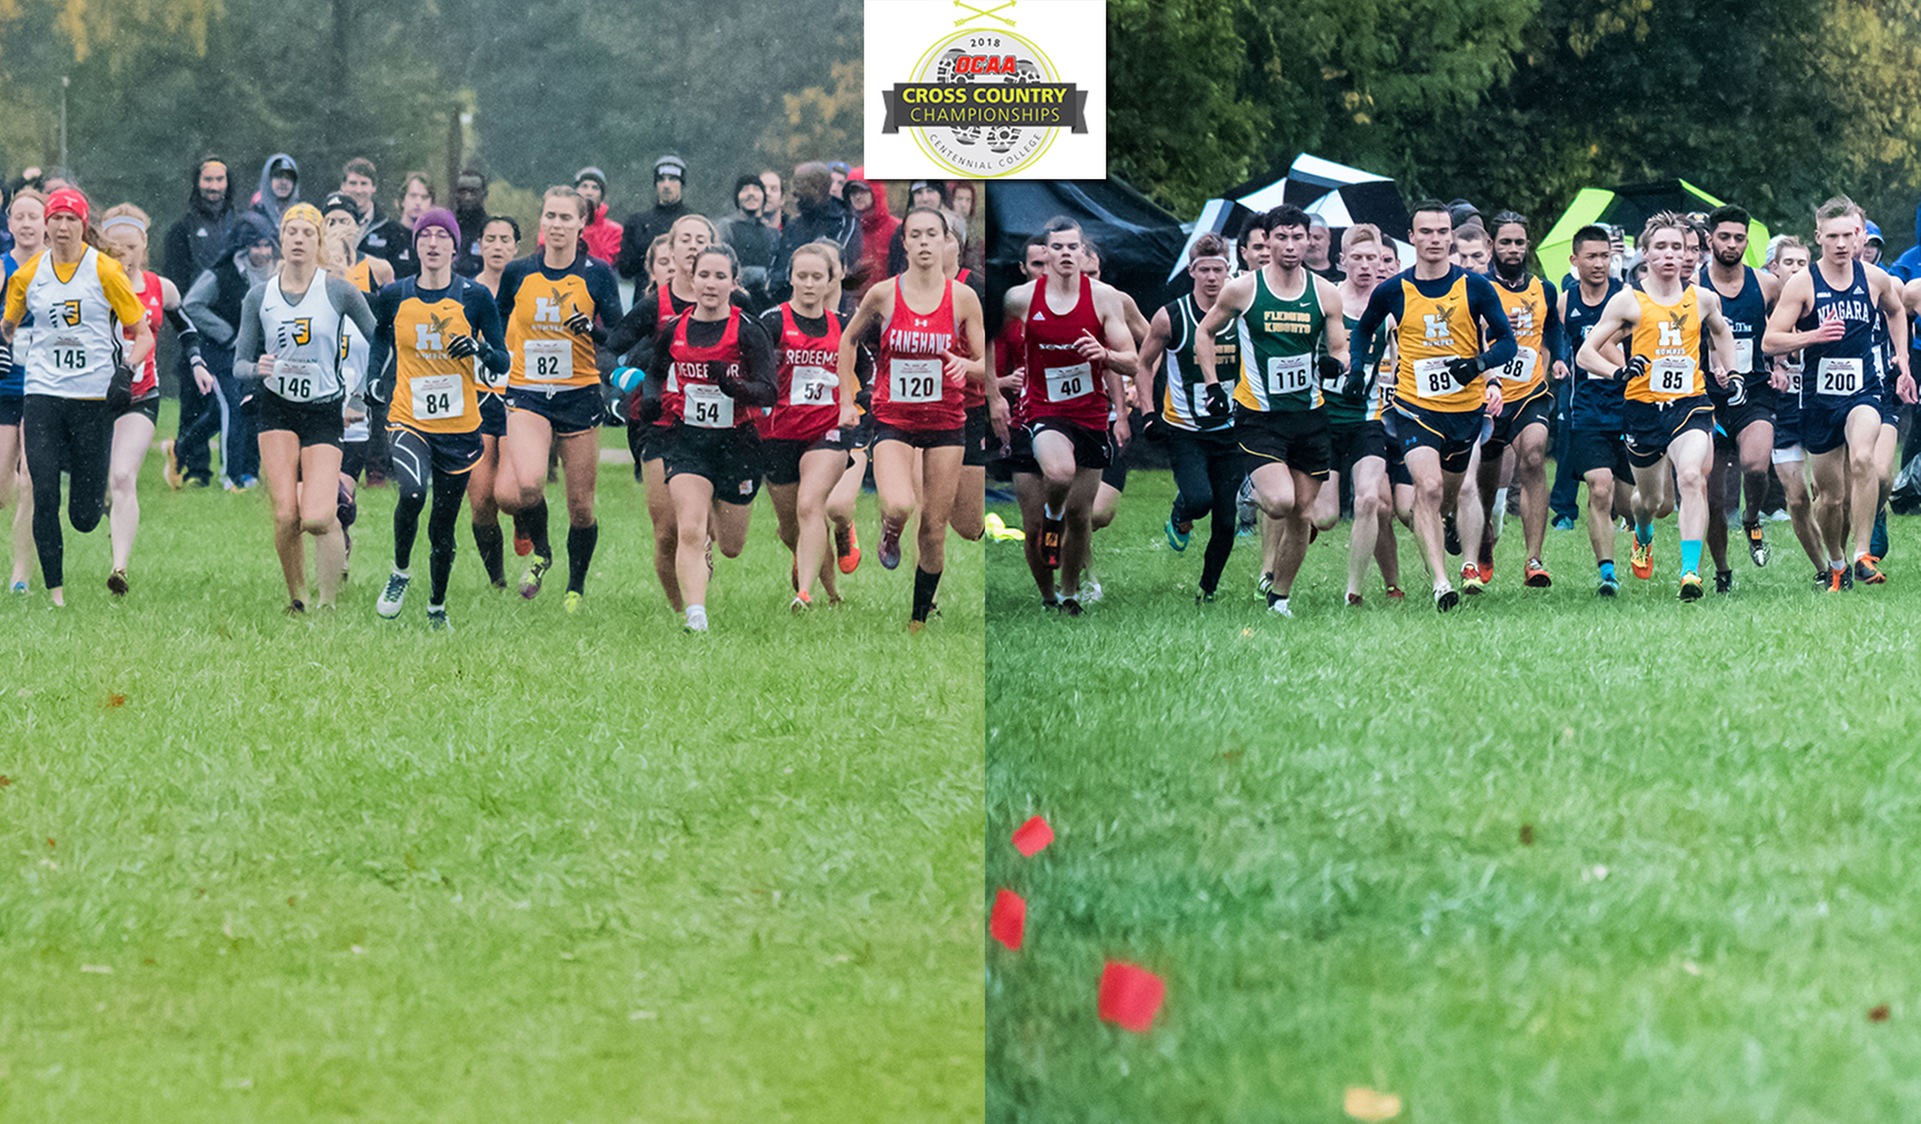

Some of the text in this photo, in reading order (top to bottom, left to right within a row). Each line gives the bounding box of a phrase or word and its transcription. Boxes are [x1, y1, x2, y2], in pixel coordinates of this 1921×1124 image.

[1817, 300, 1870, 327] NIAGARA
[890, 328, 952, 354] FANSHAWE
[53, 349, 87, 369] 145
[537, 356, 560, 376] 82
[1503, 360, 1524, 378] 88
[278, 376, 312, 399] 146
[899, 377, 935, 398] 120
[1061, 377, 1081, 396] 40
[1276, 369, 1307, 390] 116
[1429, 371, 1451, 392] 89
[1662, 370, 1683, 389] 85
[1824, 372, 1856, 391] 200
[804, 382, 824, 400] 53
[426, 392, 450, 415] 84
[696, 402, 720, 423] 54
